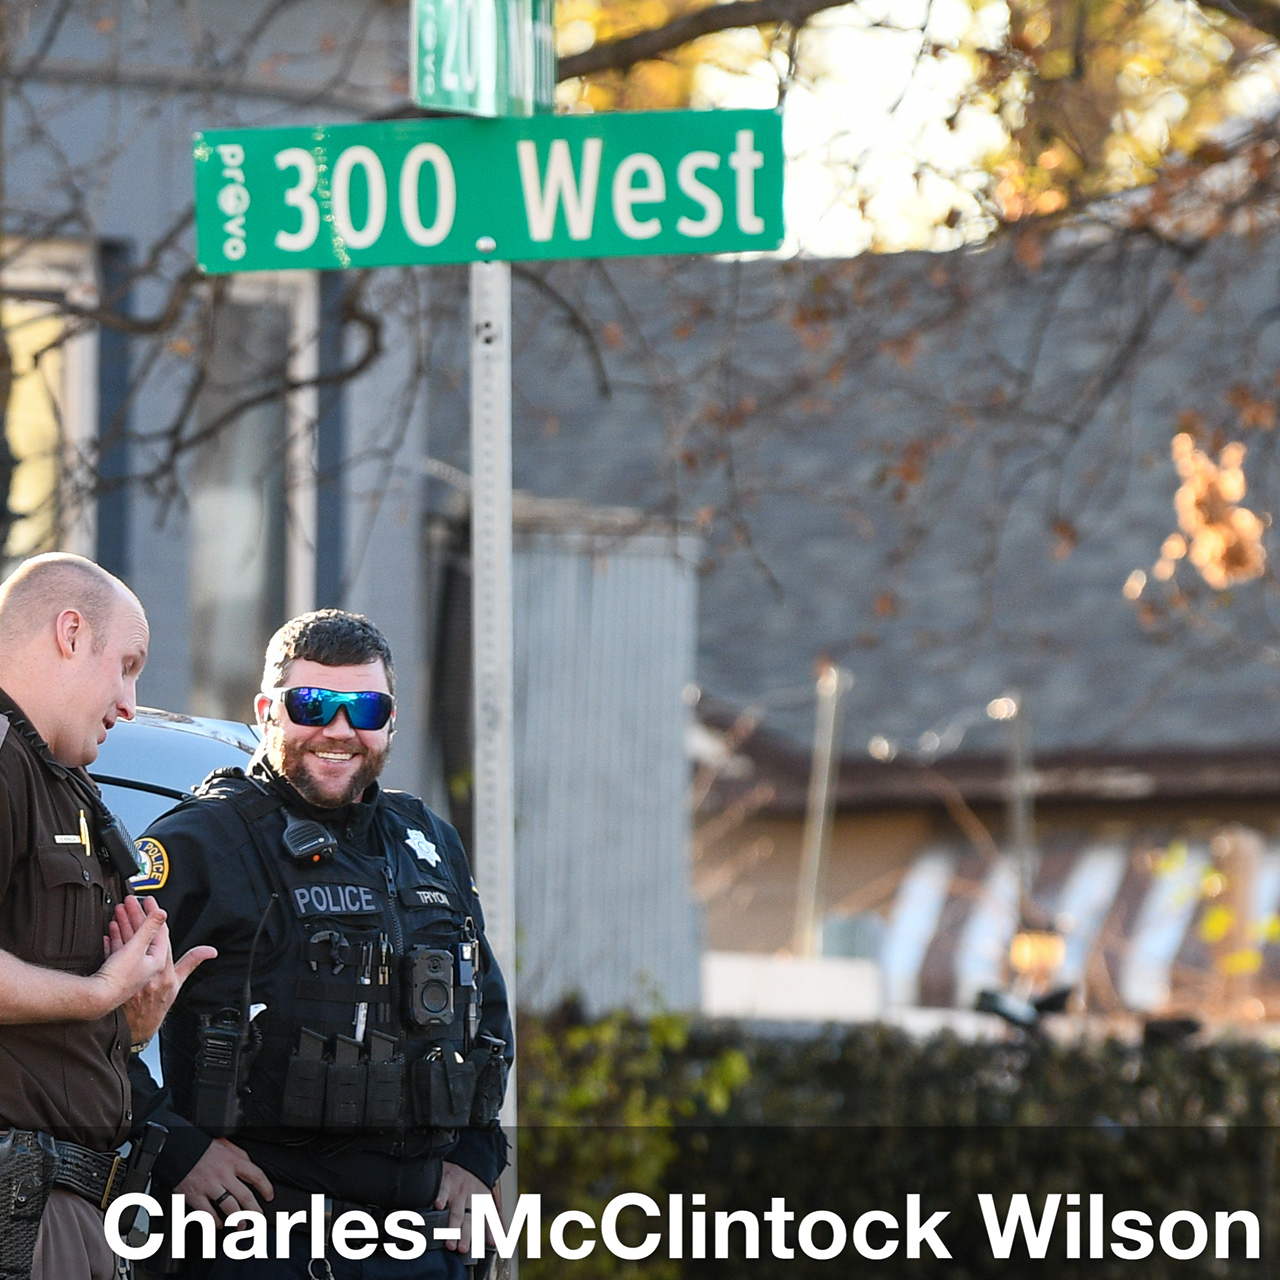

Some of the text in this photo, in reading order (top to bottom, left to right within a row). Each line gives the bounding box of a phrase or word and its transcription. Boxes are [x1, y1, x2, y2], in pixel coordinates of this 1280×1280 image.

[216, 144, 251, 261] provo
[274, 130, 765, 252] 300 West
[143, 842, 164, 881] POLICE
[294, 885, 376, 914] POLICE
